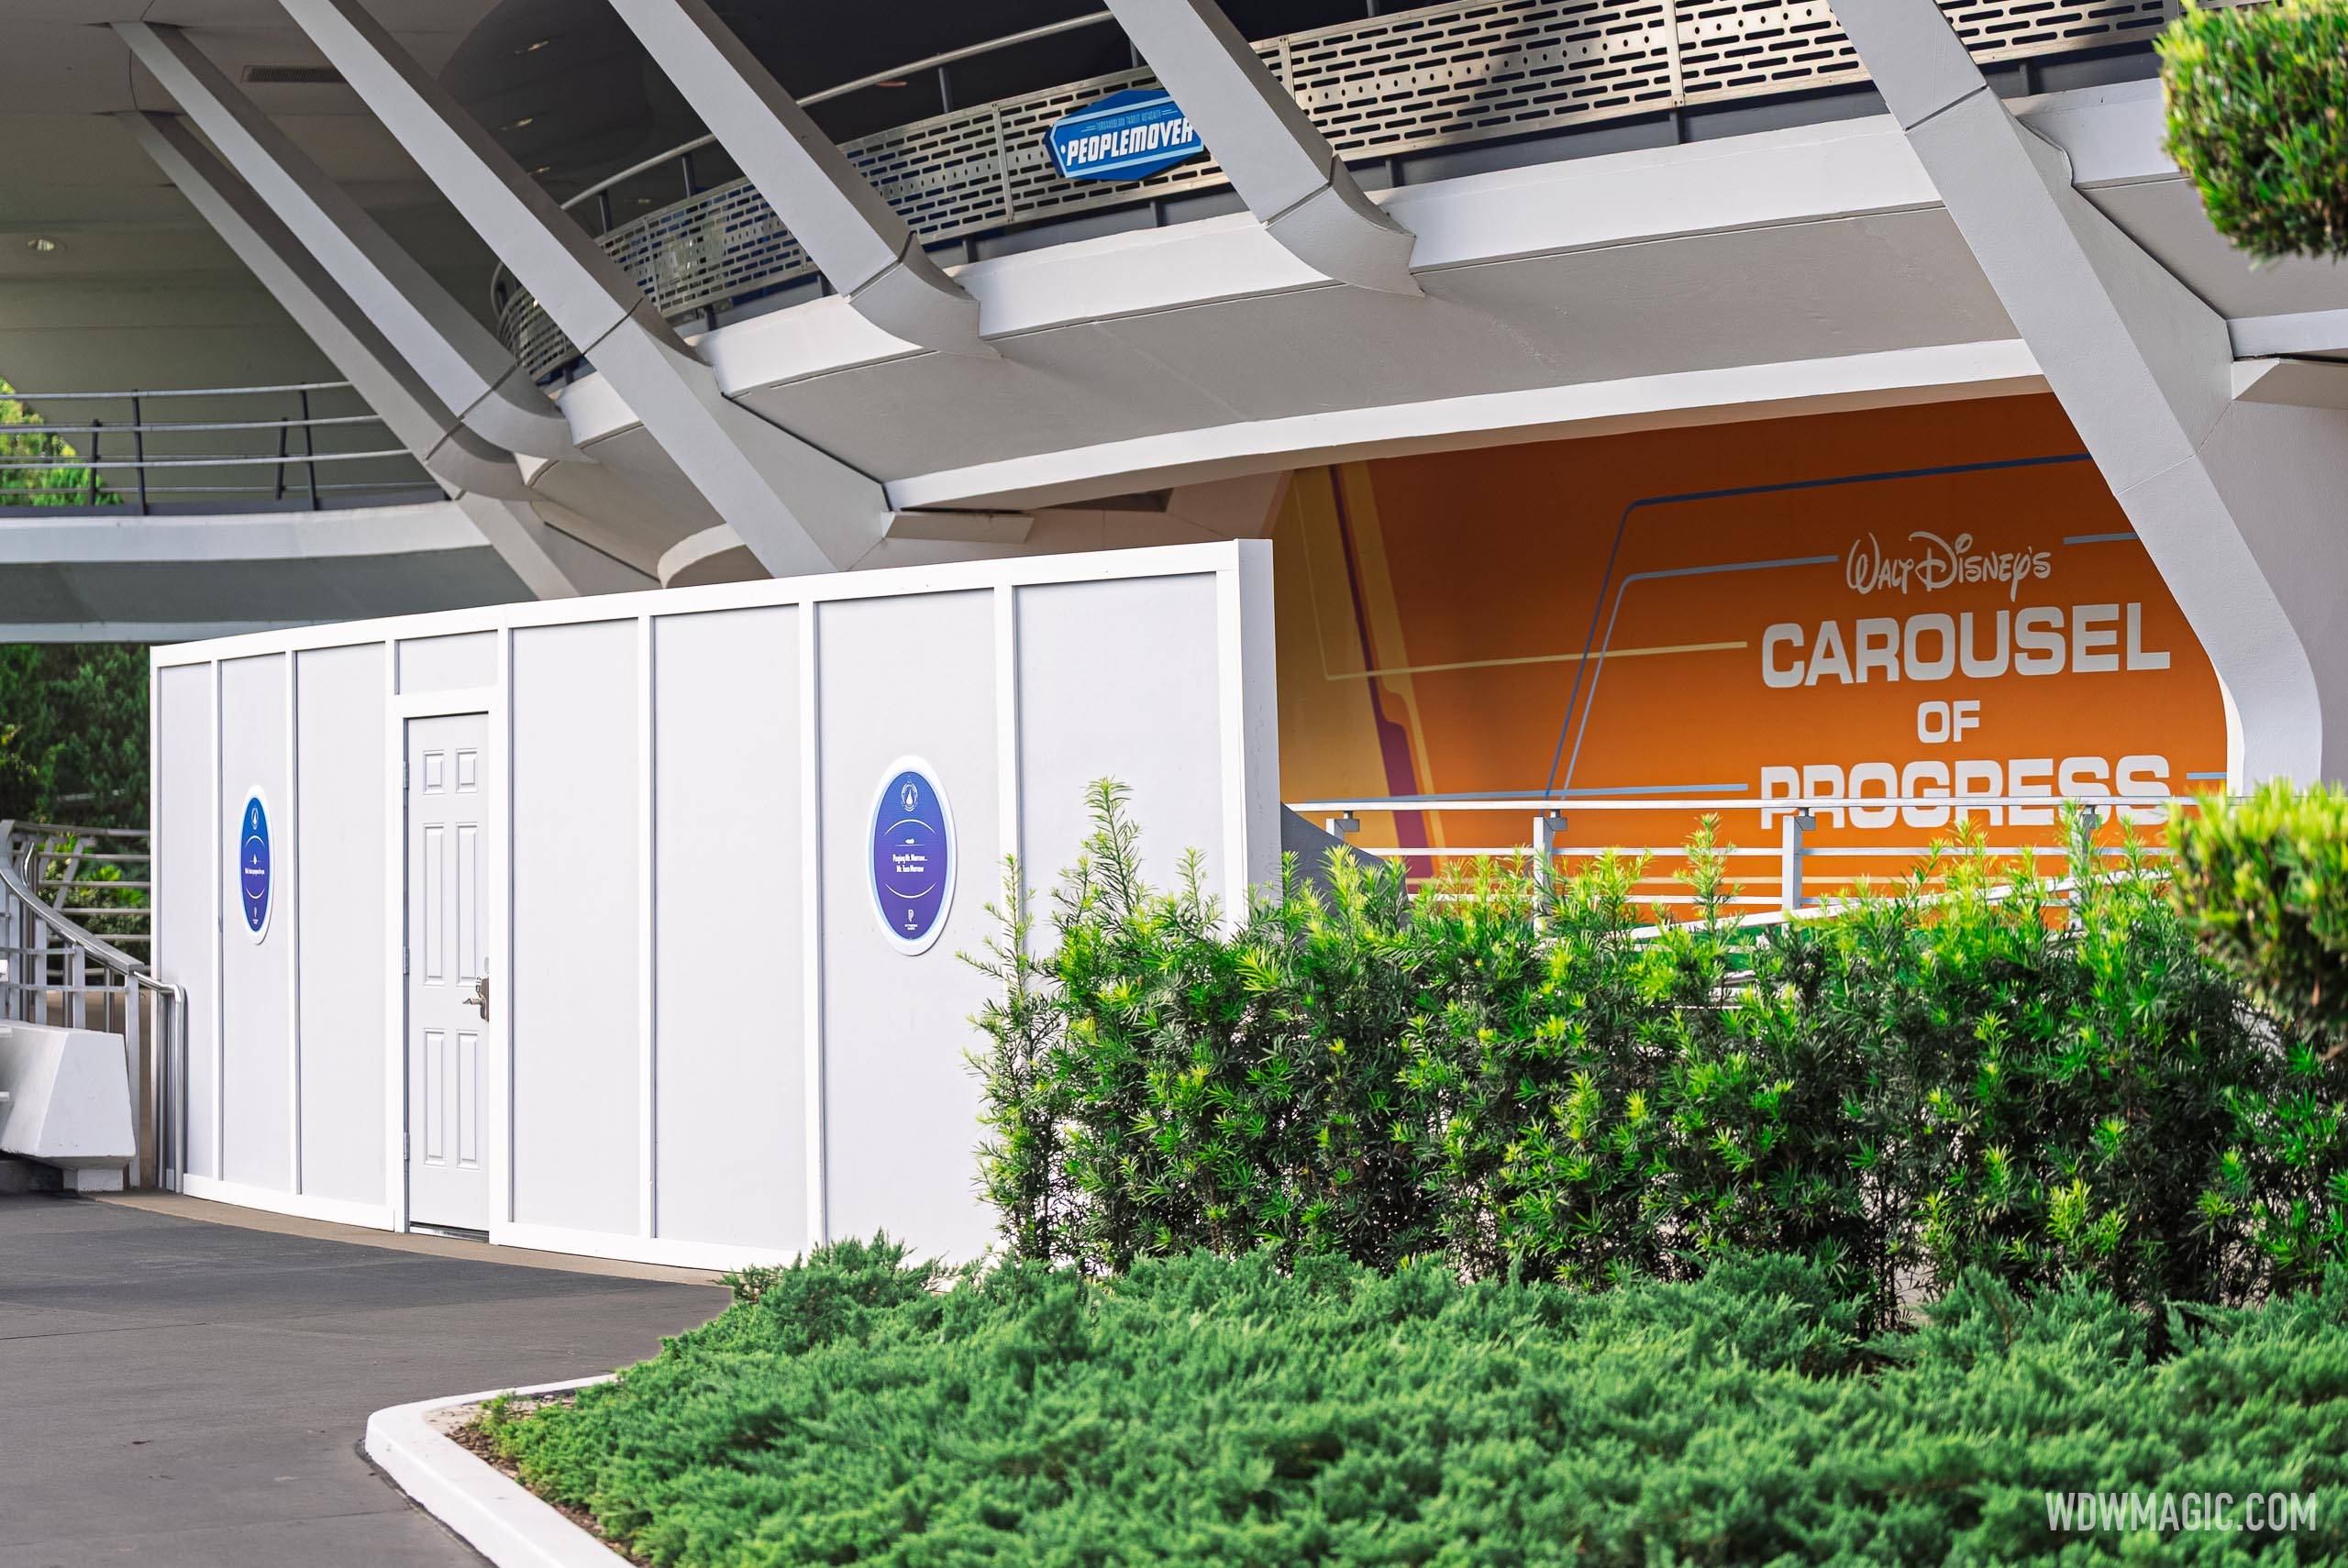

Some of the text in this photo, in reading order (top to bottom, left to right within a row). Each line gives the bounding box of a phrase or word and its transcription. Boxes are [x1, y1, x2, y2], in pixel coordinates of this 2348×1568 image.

[1762, 602, 2171, 688] CAROUSEL
[1917, 700, 1980, 744] OF
[1760, 755, 2171, 830] PROGRESS
